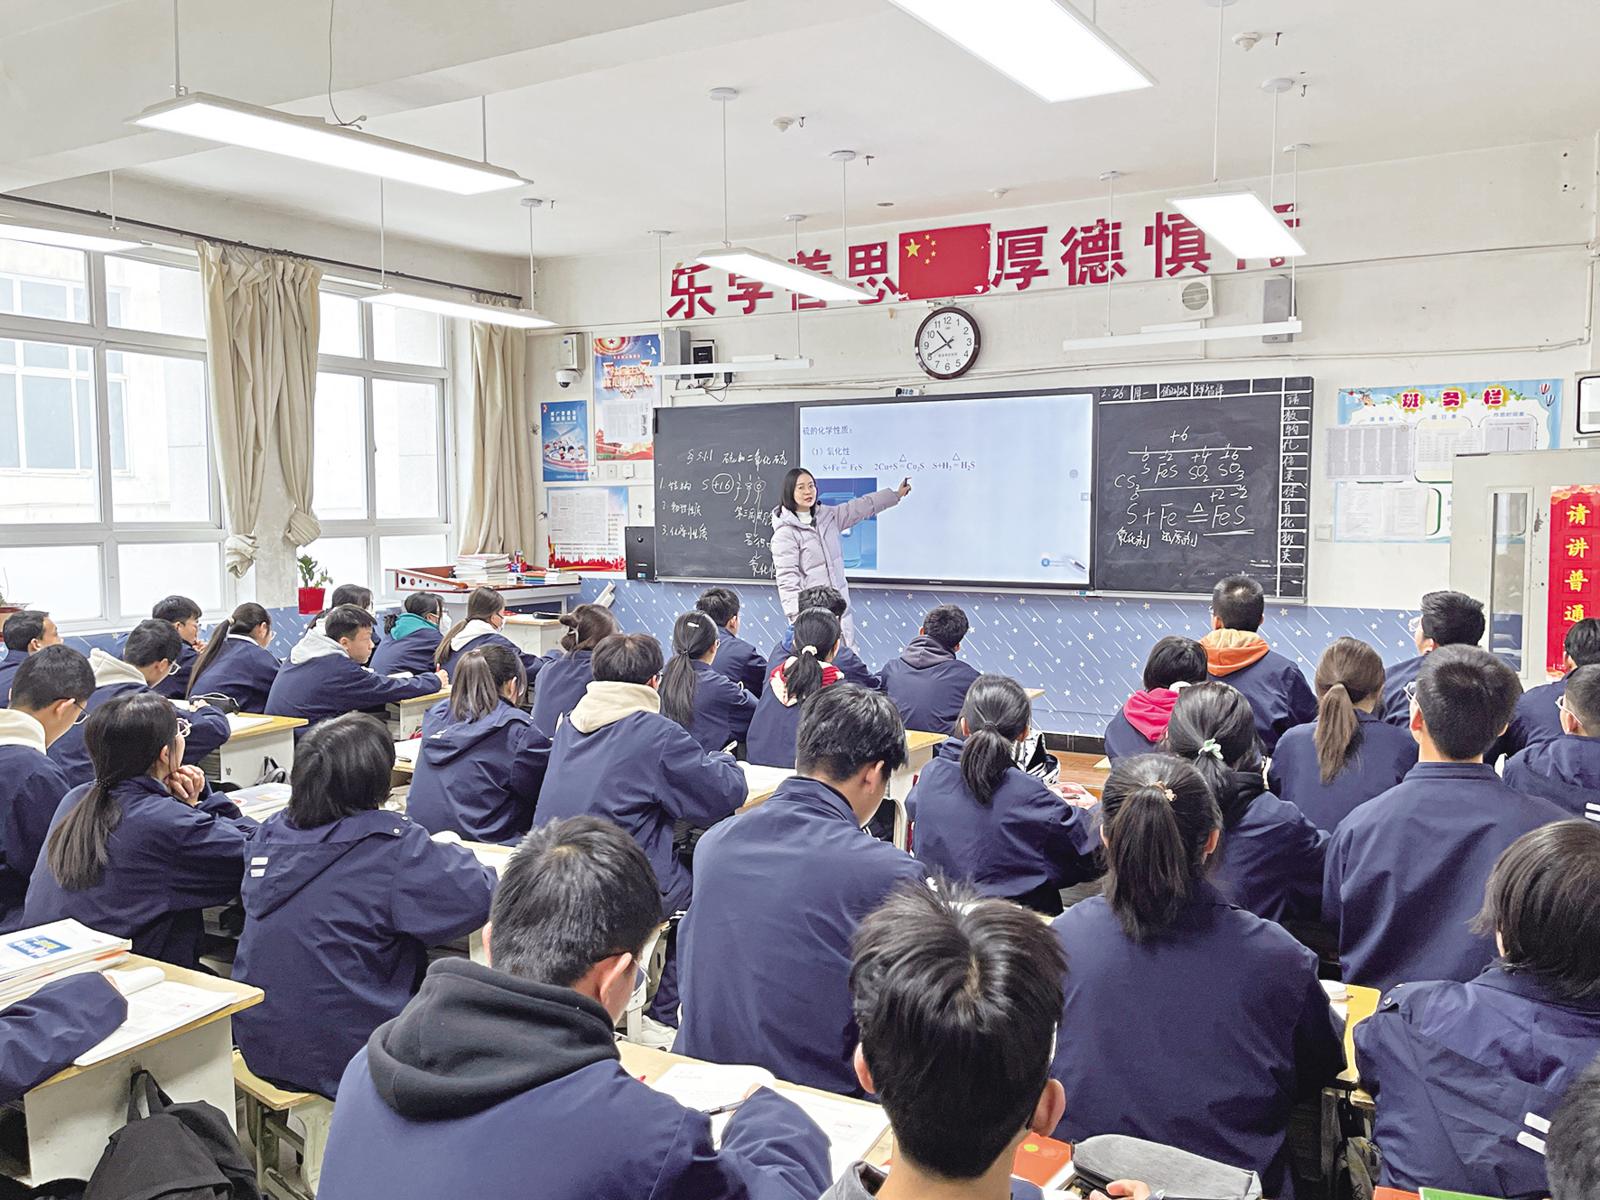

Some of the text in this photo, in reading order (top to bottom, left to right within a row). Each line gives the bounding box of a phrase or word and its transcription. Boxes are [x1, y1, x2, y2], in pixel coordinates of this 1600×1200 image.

[991, 203, 1300, 291] 厚德慎
[944, 316, 951, 324] 12
[927, 330, 935, 339] 10
[963, 327, 969, 335] 2
[923, 341, 929, 350] 9
[966, 338, 972, 346] 3
[944, 362, 950, 371] 6
[955, 359, 961, 367] 5
[1101, 388, 1125, 399] 2.26
[1402, 389, 1502, 408] 班务栏
[1170, 426, 1190, 444] +6
[1155, 463, 1178, 484] FeS
